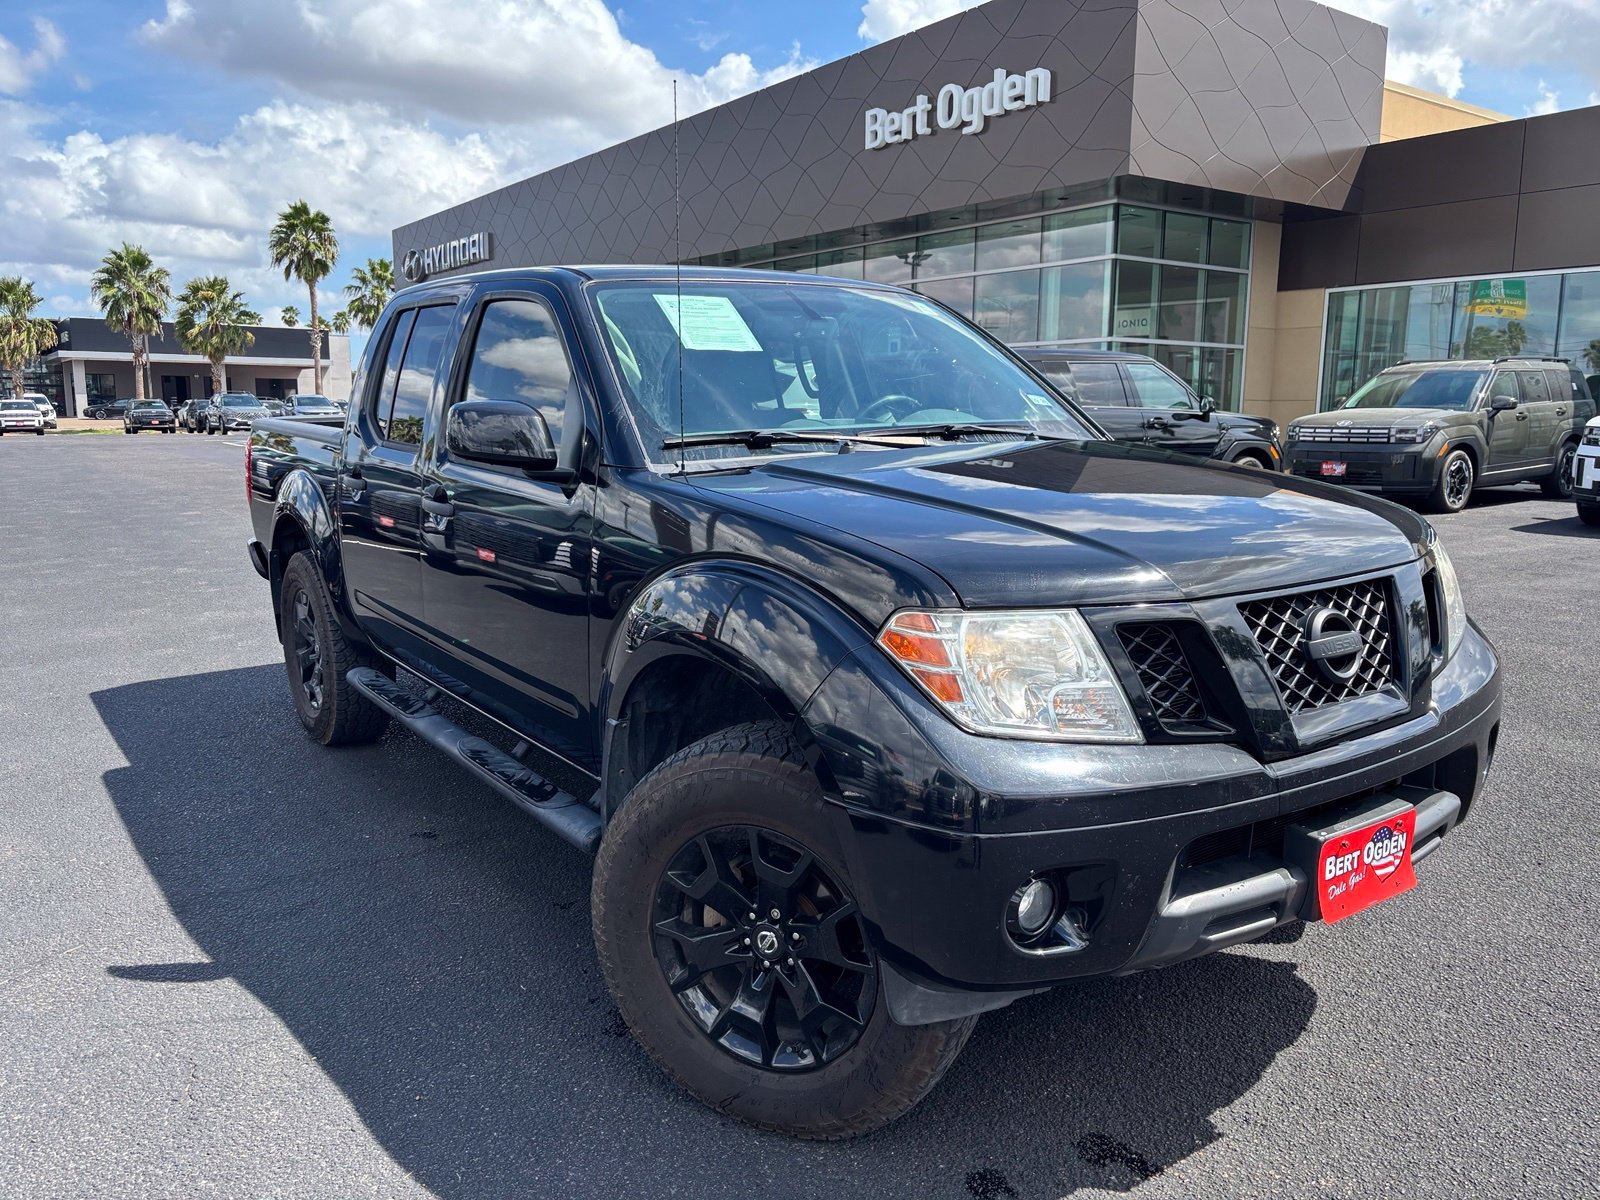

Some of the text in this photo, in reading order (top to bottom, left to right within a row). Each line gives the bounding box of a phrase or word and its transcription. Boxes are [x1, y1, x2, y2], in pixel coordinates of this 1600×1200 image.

[865, 67, 1051, 149] Bert Ogden
[424, 232, 489, 274] HYUNDAI
[1325, 832, 1407, 881] BERT OGDEN
[1327, 865, 1368, 901] Dale Gas!
